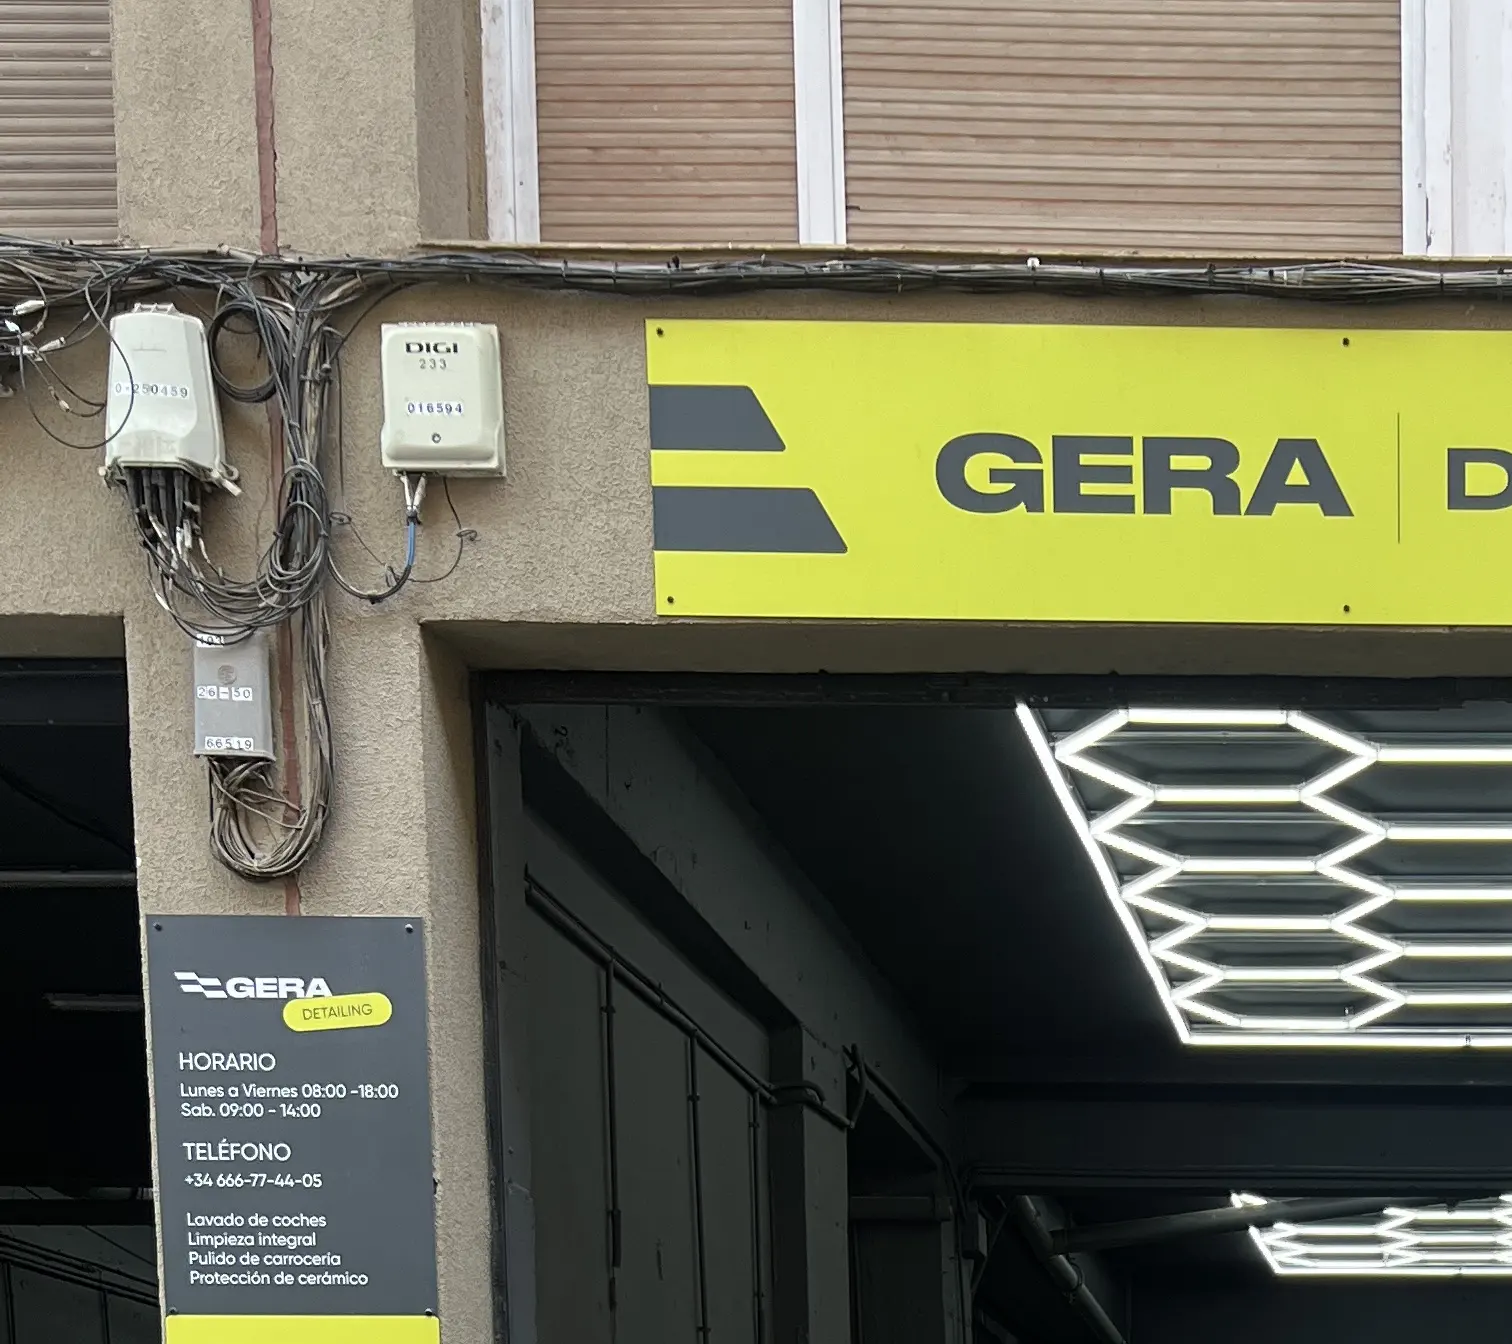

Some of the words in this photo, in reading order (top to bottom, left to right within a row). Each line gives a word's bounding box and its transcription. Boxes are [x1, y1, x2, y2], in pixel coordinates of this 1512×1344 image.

[405, 342, 459, 353] DIGI
[935, 433, 1355, 517] GERA
[226, 976, 333, 999] GERA
[302, 1003, 373, 1021] DETAILING
[179, 1052, 276, 1072] HORARIO
[180, 1082, 225, 1099] Lunes
[228, 1087, 239, 1099] a
[241, 1082, 299, 1099] Viernes
[301, 1083, 347, 1099] 08:00
[181, 1103, 216, 1118] Sab.
[219, 1103, 264, 1118] 09:00
[280, 1103, 321, 1118] 14:00
[183, 1139, 292, 1161] TELÉFONO
[184, 1173, 214, 1188] +34
[216, 1173, 323, 1188] 666-77-44-05
[187, 1212, 245, 1228] Lavado
[248, 1212, 269, 1228] de
[272, 1212, 327, 1228] coches
[188, 1231, 255, 1249] Limpieza
[258, 1231, 316, 1249] integral
[189, 1251, 236, 1267] Pulido
[239, 1251, 260, 1267] de
[190, 1270, 270, 1286] Protección
[273, 1270, 294, 1286] de
[298, 1270, 369, 1286] cerámico
